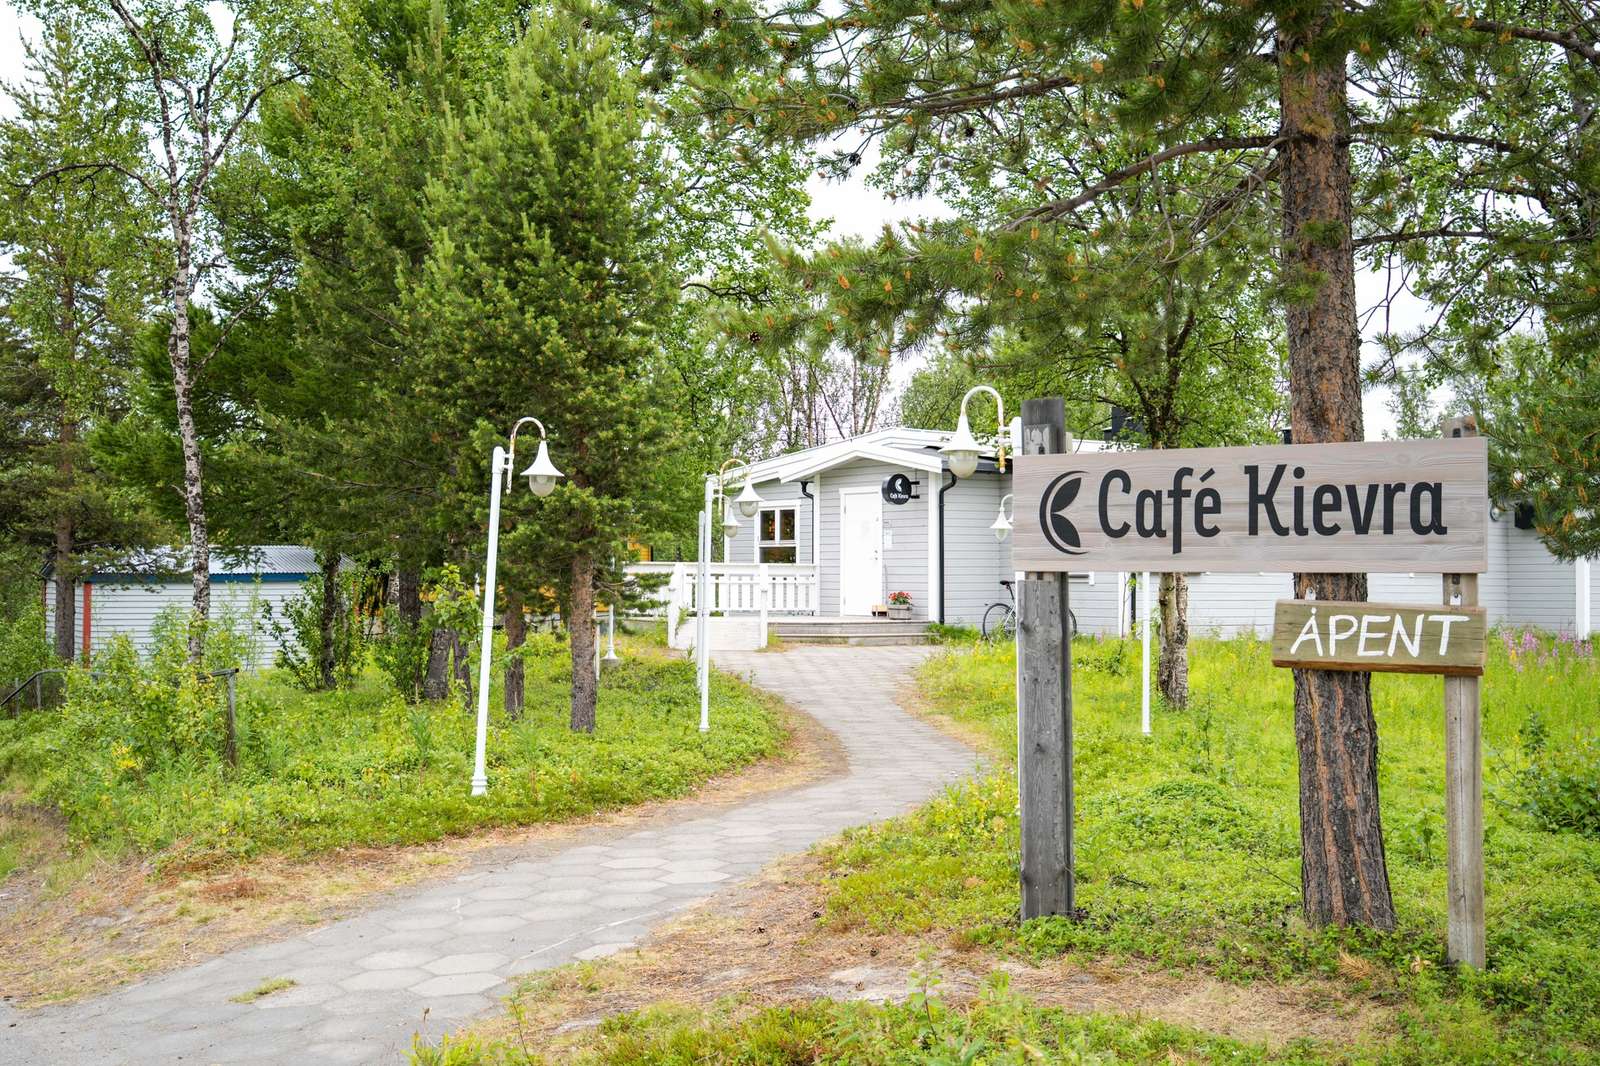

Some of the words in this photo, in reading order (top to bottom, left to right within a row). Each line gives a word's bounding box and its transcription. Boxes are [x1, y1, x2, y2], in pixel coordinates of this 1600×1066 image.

[1098, 467, 1222, 555] Café
[1244, 464, 1447, 537] Kievra
[1290, 607, 1470, 658] ÅPENT
